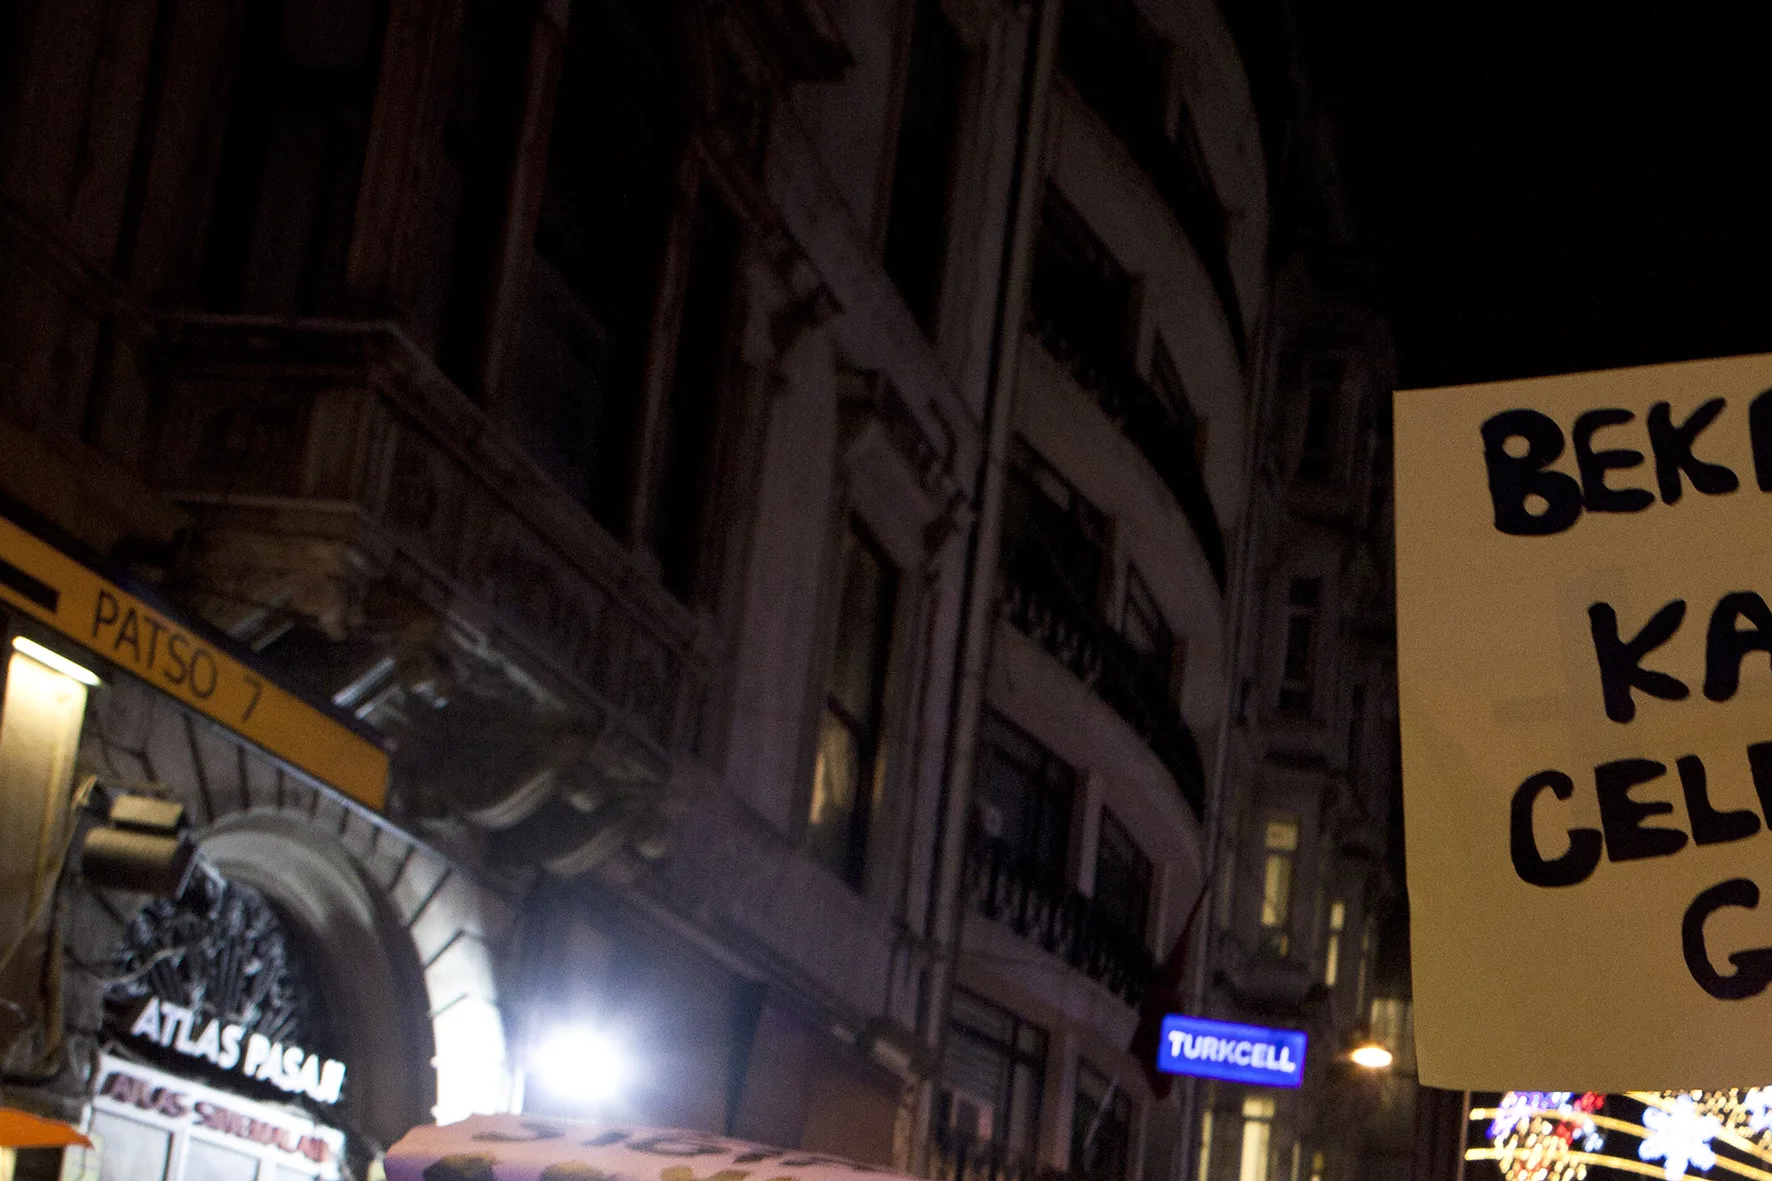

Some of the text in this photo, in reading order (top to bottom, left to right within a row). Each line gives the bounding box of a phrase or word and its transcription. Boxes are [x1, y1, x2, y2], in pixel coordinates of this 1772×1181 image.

[92, 587, 263, 722] PATSO 7
[131, 996, 247, 1070] ATLAS
[1168, 1030, 1296, 1074] TURKCELL
